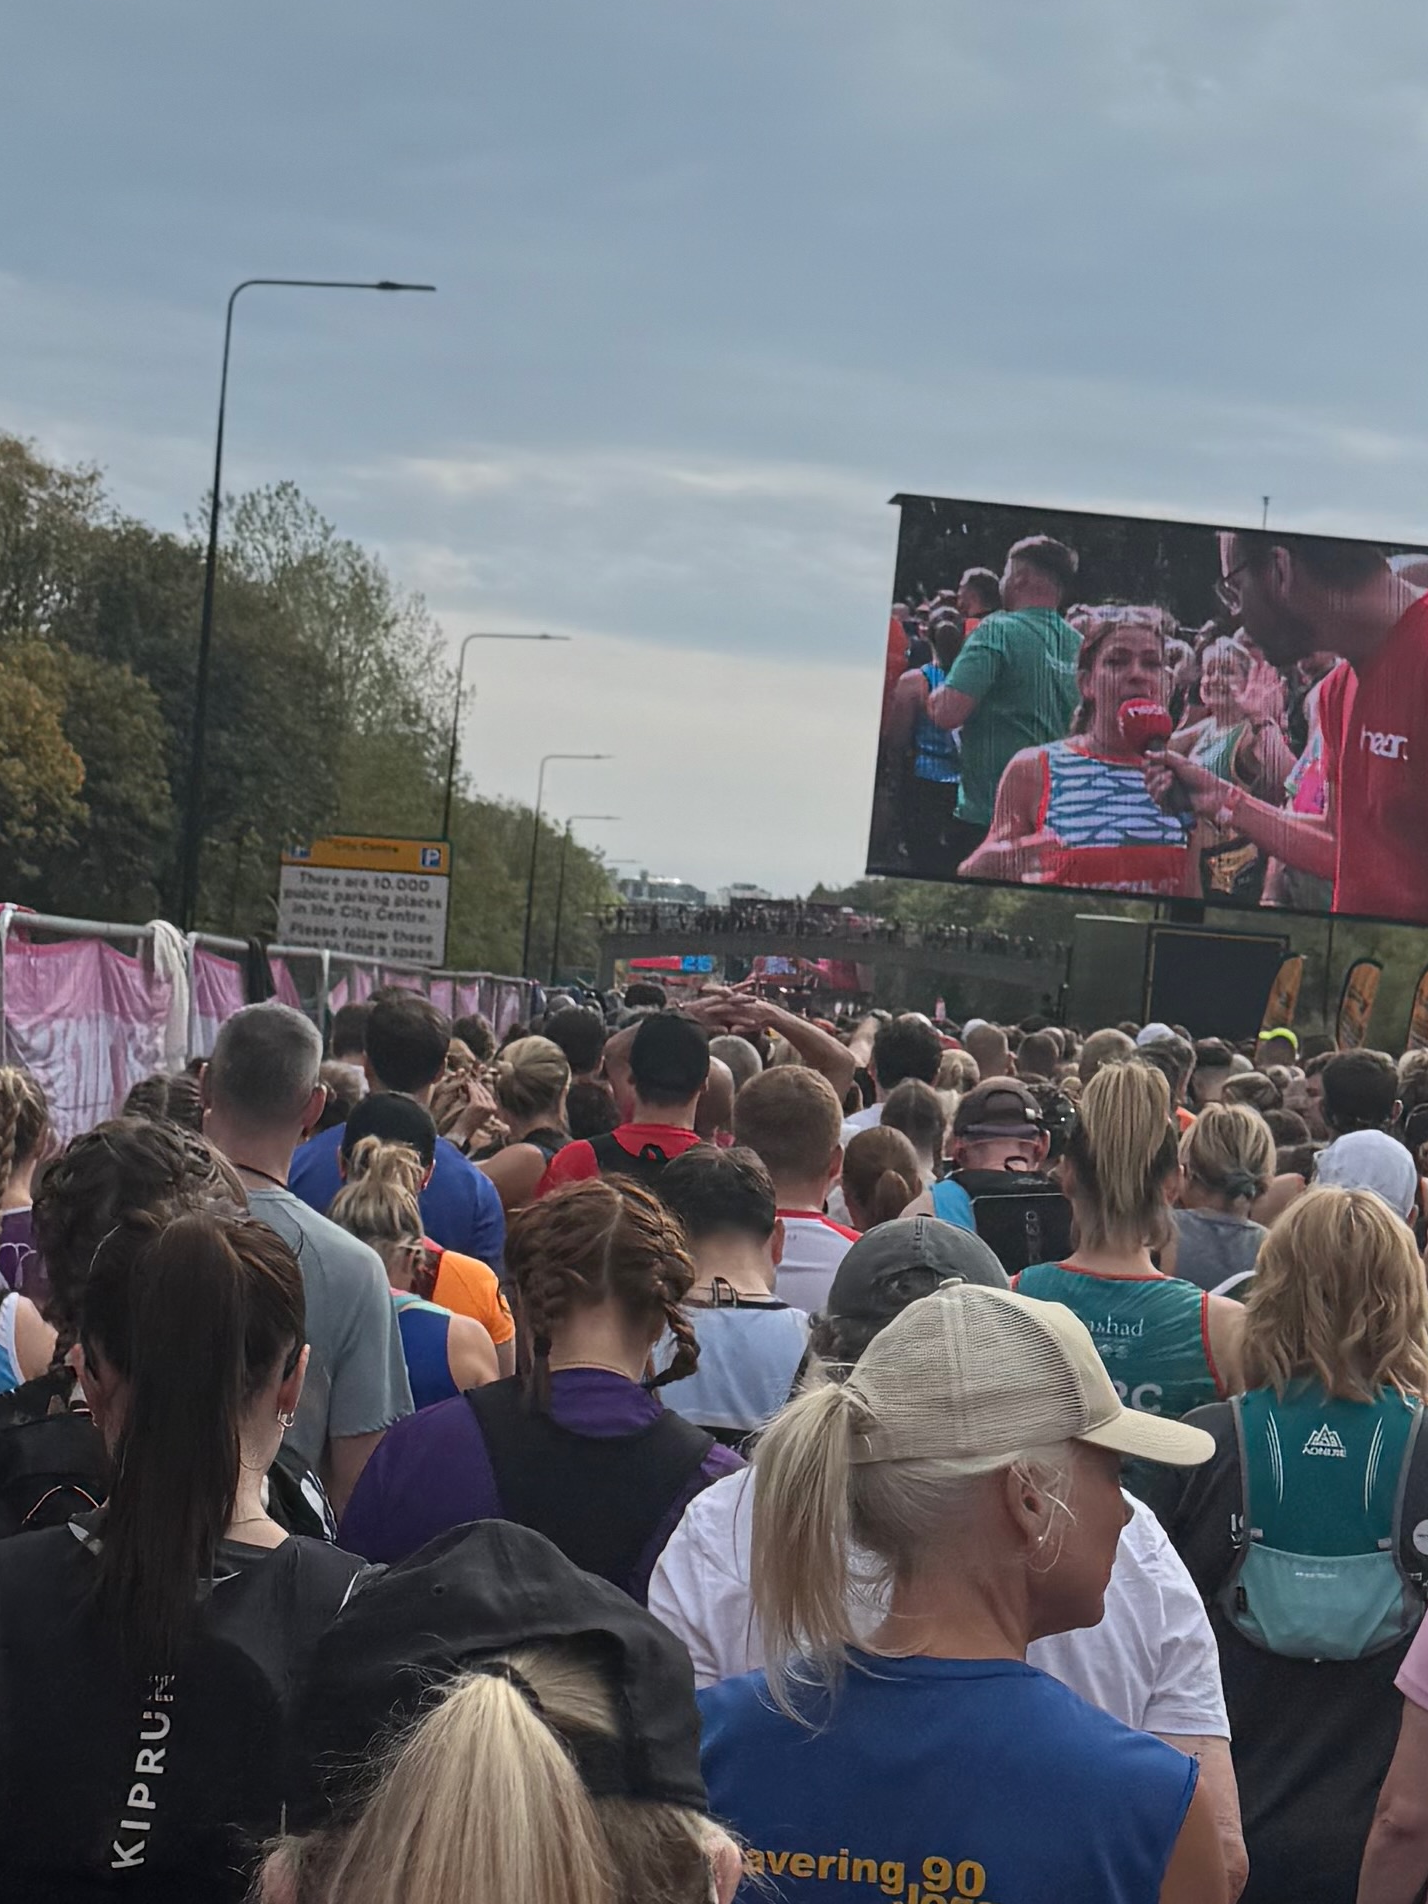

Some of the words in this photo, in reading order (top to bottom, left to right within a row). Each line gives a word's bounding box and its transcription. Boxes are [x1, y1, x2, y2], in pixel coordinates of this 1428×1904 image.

[299, 870, 341, 886] There
[344, 876, 369, 888] are
[333, 892, 390, 908] parking
[393, 895, 442, 910] places
[291, 902, 307, 914] in
[311, 903, 335, 916] the
[339, 905, 370, 922] City
[289, 921, 338, 937] Please
[341, 926, 389, 941] follow
[393, 929, 434, 944] these
[744, 1847, 906, 1896] avering
[921, 1854, 988, 1899] 90
